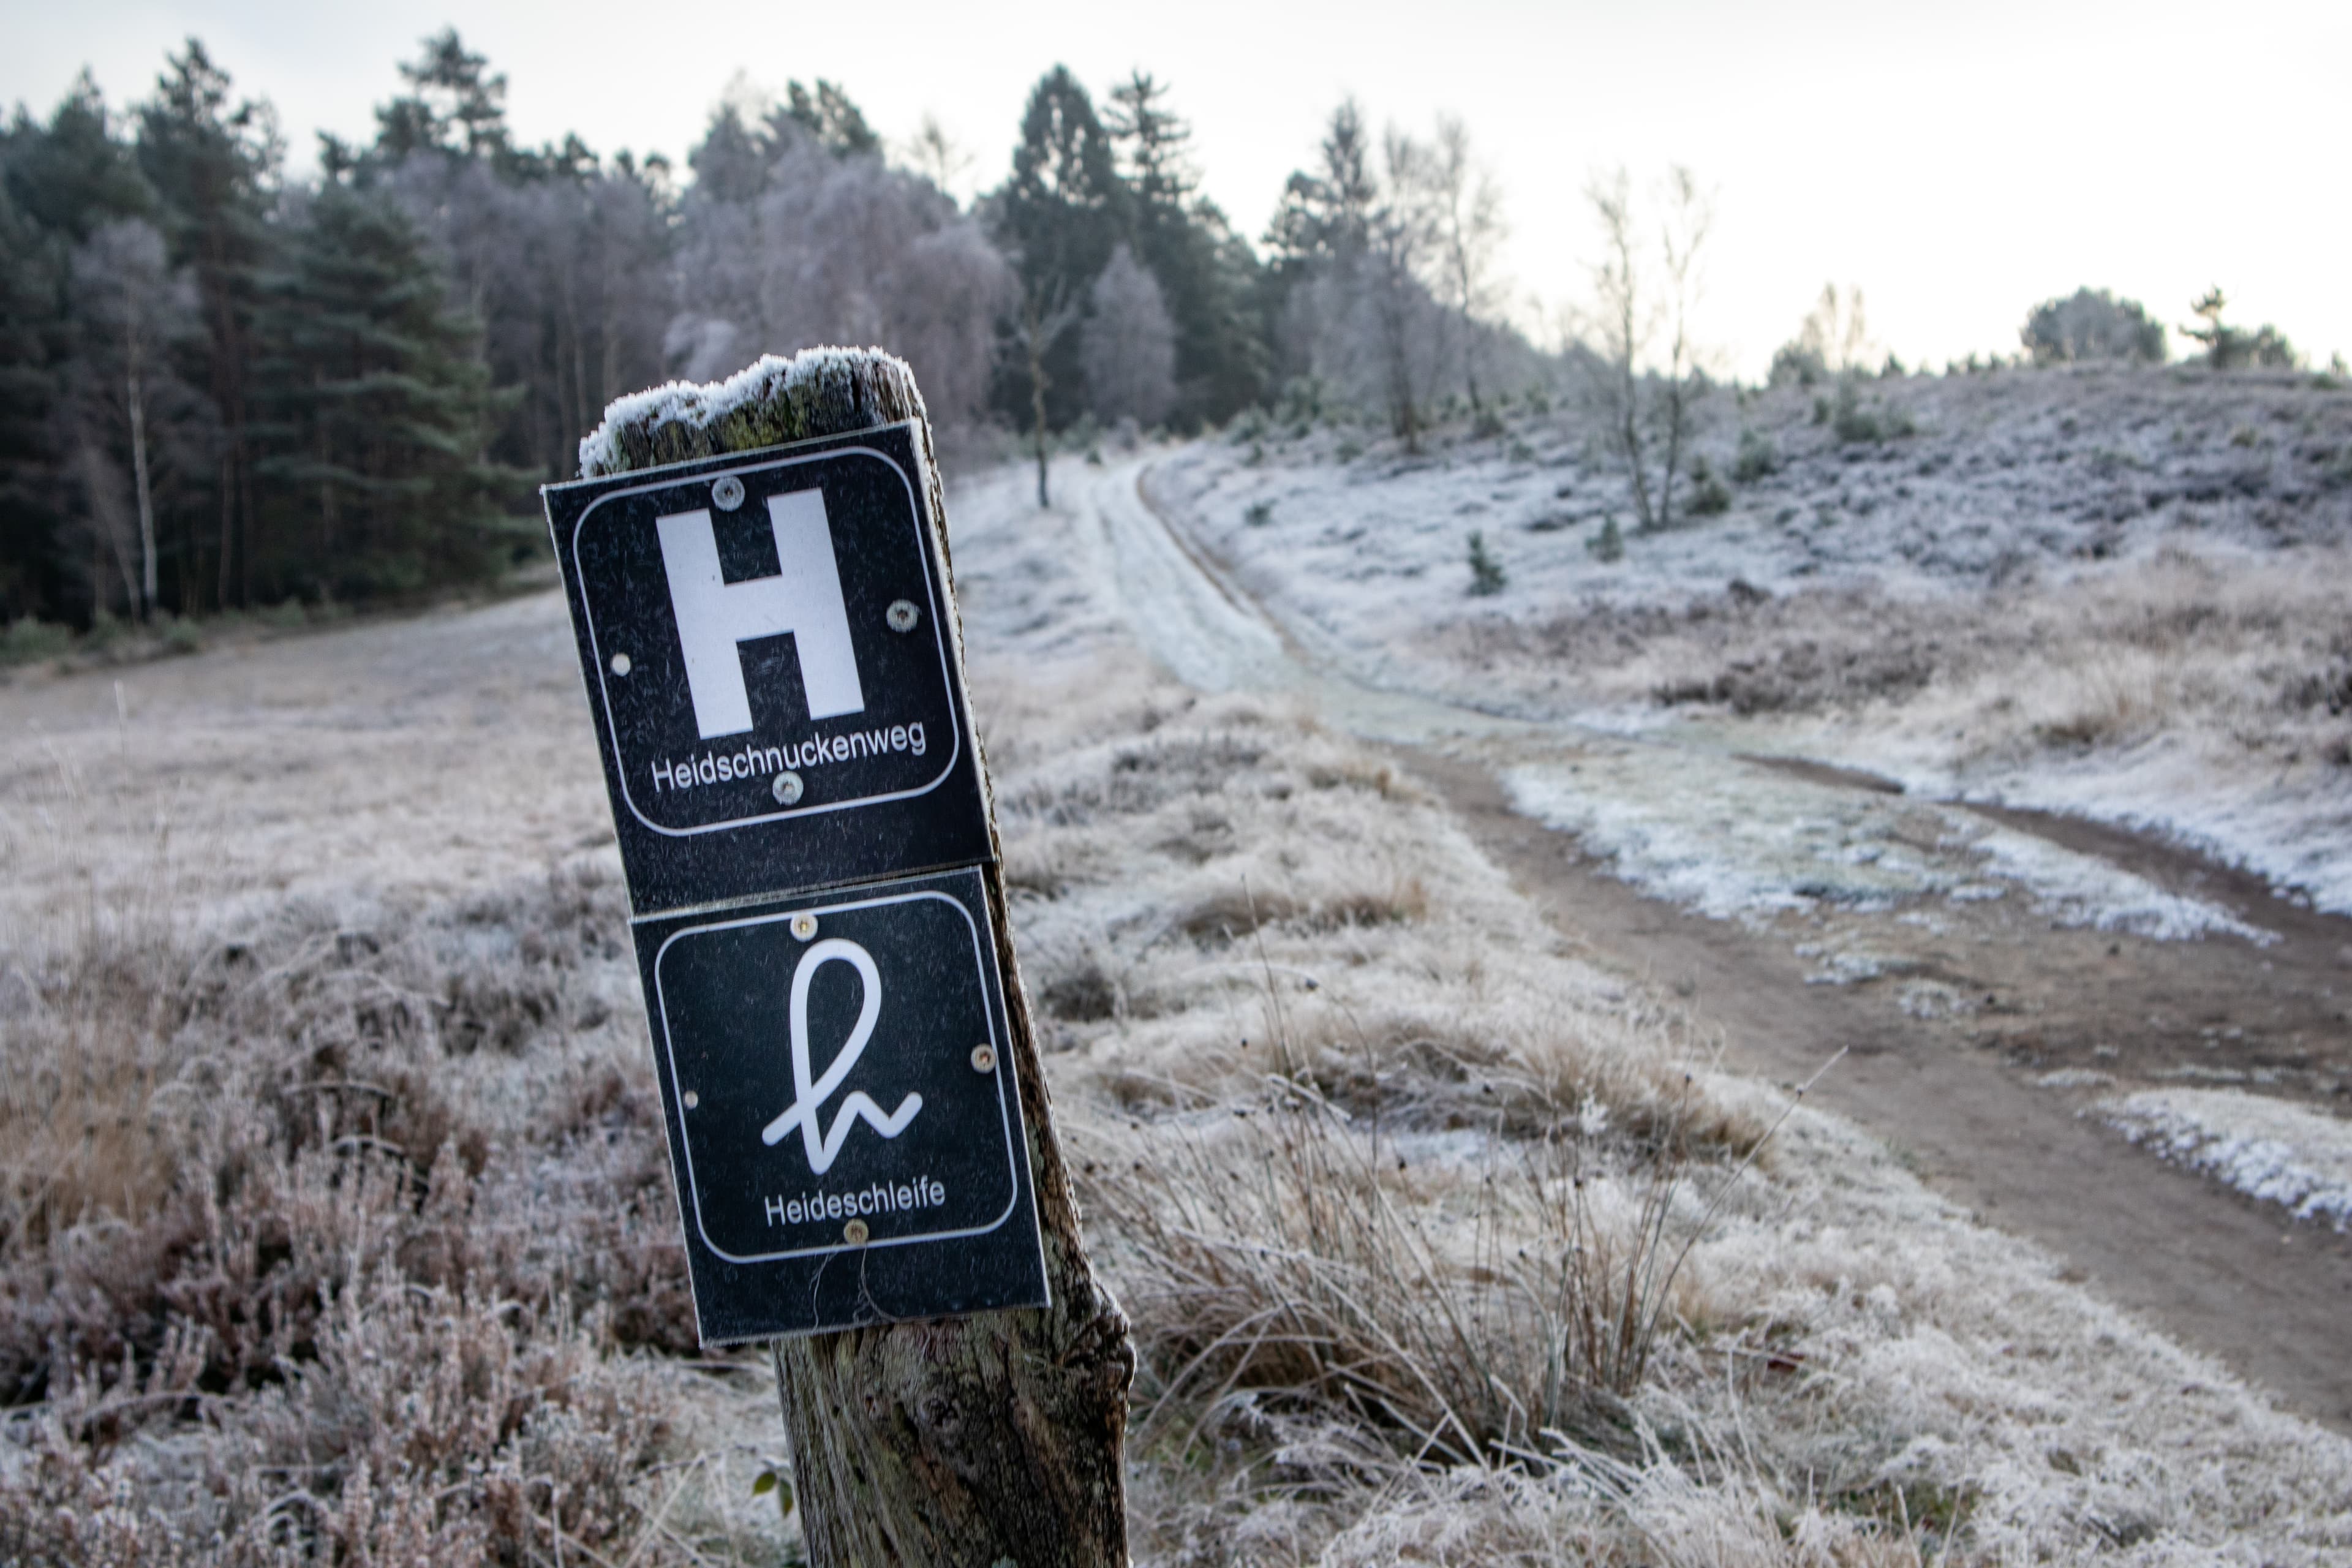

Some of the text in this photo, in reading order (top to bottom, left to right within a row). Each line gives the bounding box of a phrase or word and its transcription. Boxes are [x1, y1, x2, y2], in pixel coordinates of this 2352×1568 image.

[656, 489, 865, 740] H
[651, 722, 927, 793] Heidschnuckenweg
[764, 1175, 946, 1227] Heideschleife
